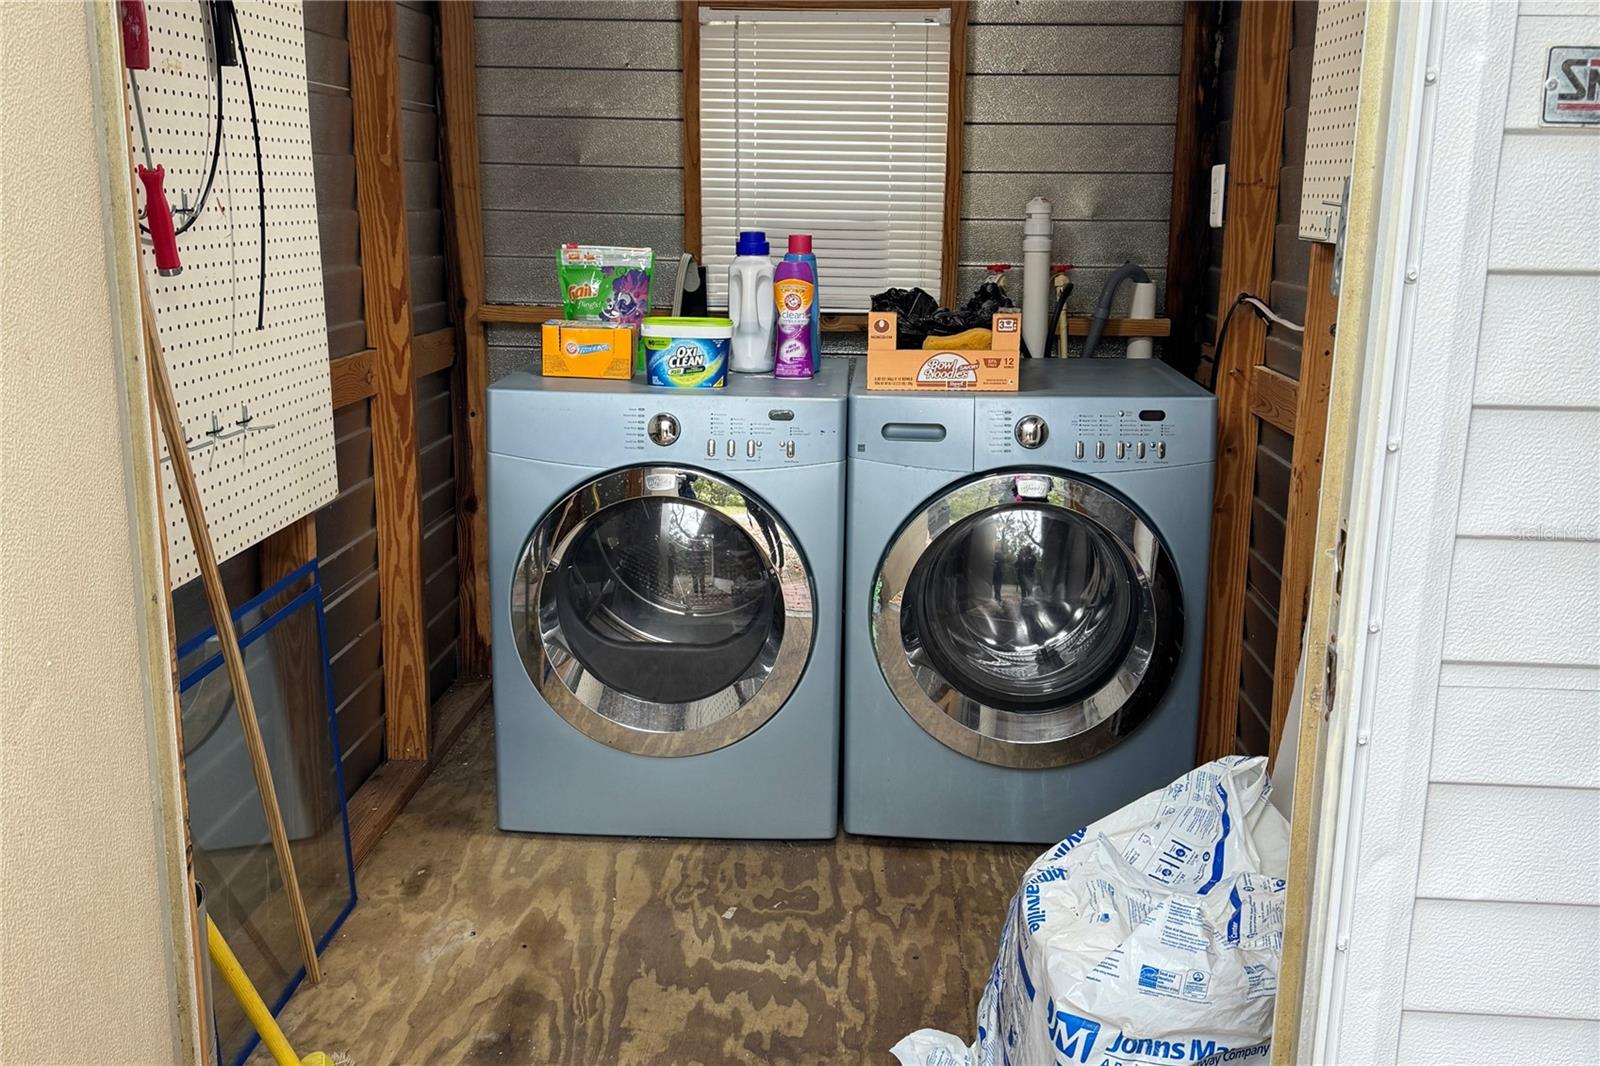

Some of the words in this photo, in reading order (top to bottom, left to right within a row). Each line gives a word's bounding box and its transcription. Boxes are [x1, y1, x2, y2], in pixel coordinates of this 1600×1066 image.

[999, 320, 1005, 330] 3
[676, 346, 699, 358] OXI
[668, 355, 705, 368] CLEAN
[927, 358, 958, 370] Bowl
[1004, 357, 1014, 365] 12
[923, 367, 969, 379] Noodles
[1223, 1043, 1271, 1062] Company
